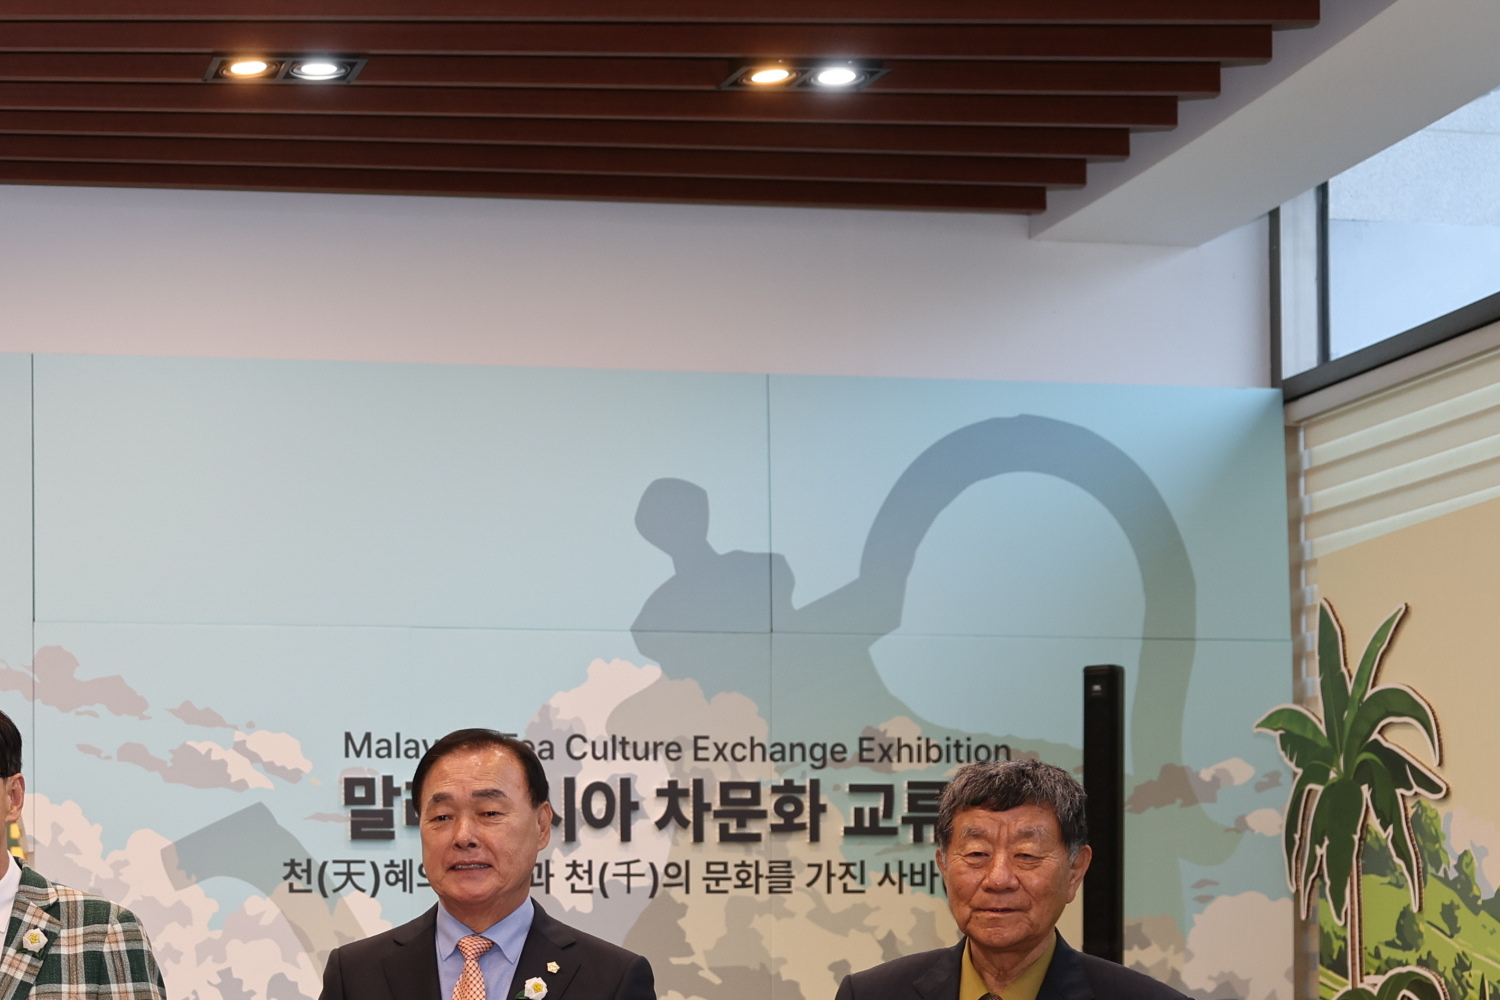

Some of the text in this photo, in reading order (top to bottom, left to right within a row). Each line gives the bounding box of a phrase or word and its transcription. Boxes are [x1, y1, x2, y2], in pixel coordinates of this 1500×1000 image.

[565, 734, 683, 761] Culture
[693, 735, 848, 770] Exchange
[858, 736, 1012, 764] Exhibition
[655, 778, 828, 843] 차문화
[565, 859, 691, 899] 천(千)의
[702, 860, 796, 895] 문화를
[805, 860, 867, 895] 가진
[877, 860, 947, 898] 사바
